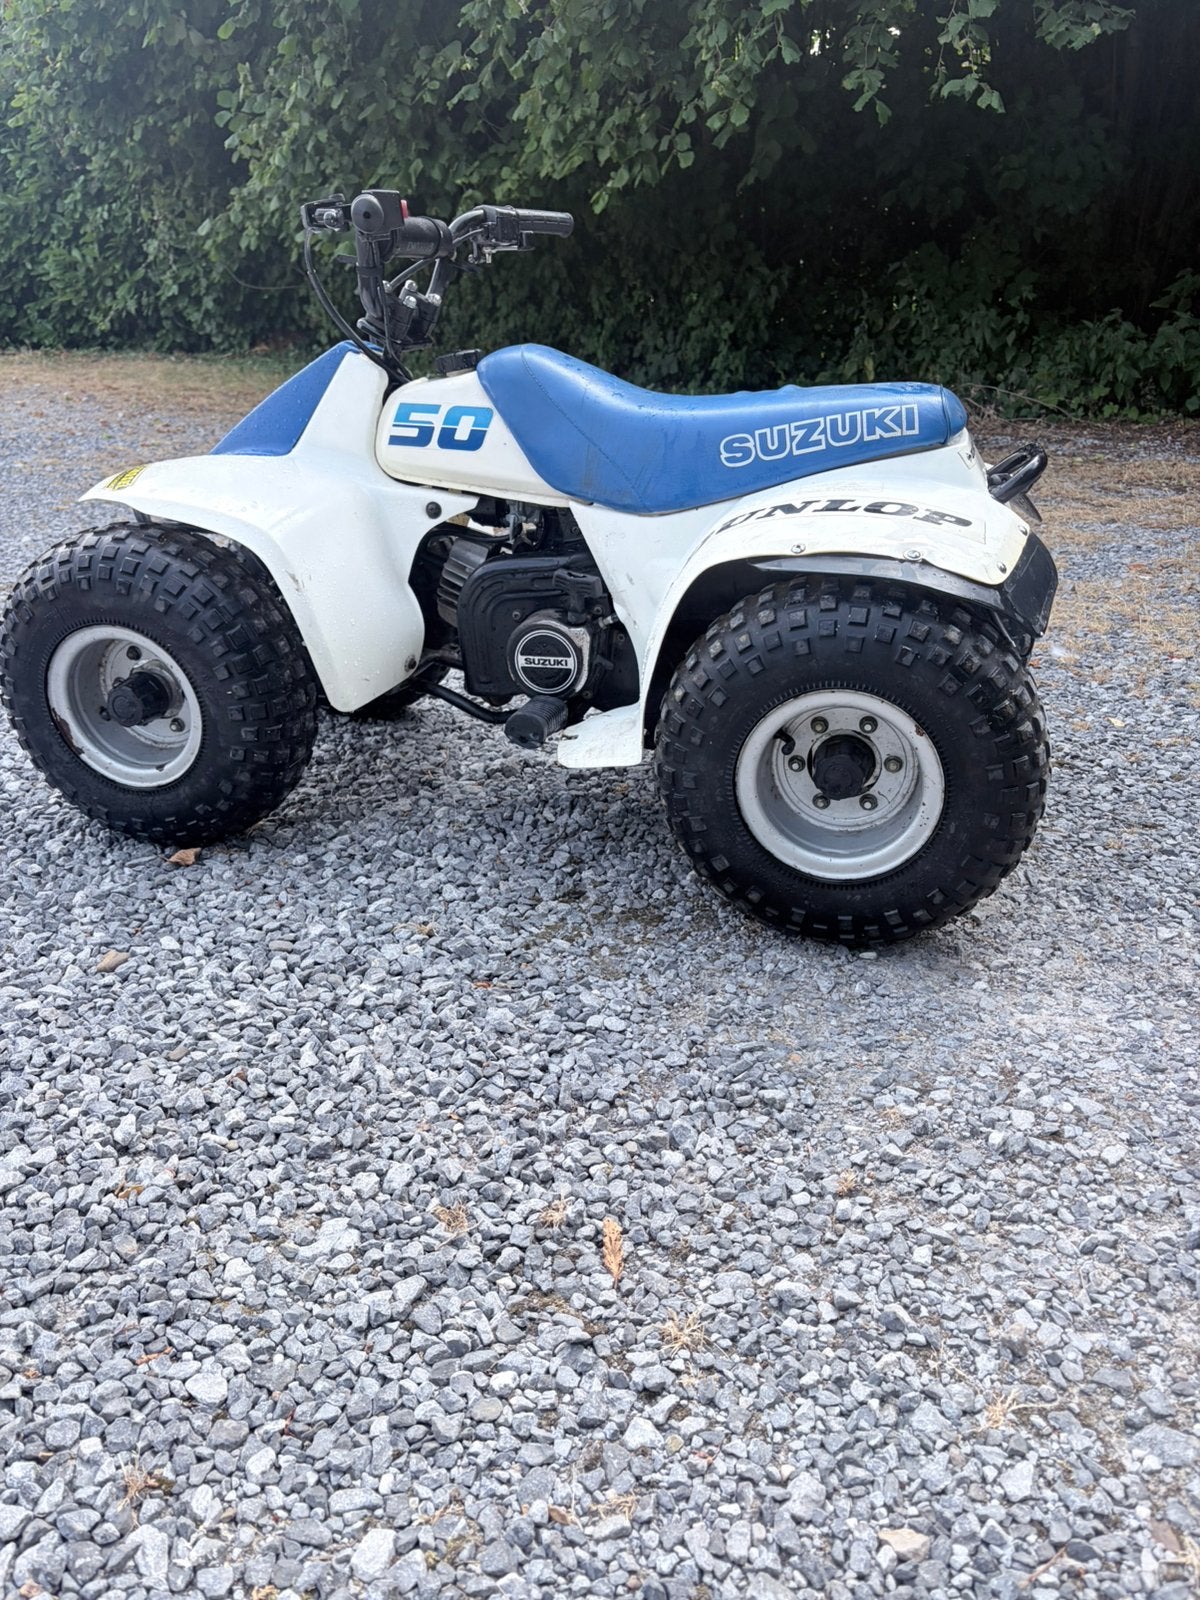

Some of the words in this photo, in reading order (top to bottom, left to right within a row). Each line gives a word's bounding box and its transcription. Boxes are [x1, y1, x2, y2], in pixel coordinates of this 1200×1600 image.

[388, 402, 494, 452] 50
[720, 404, 919, 468] SUZUKI
[704, 499, 973, 540] UNLOP
[524, 657, 568, 667] SUZUKI
